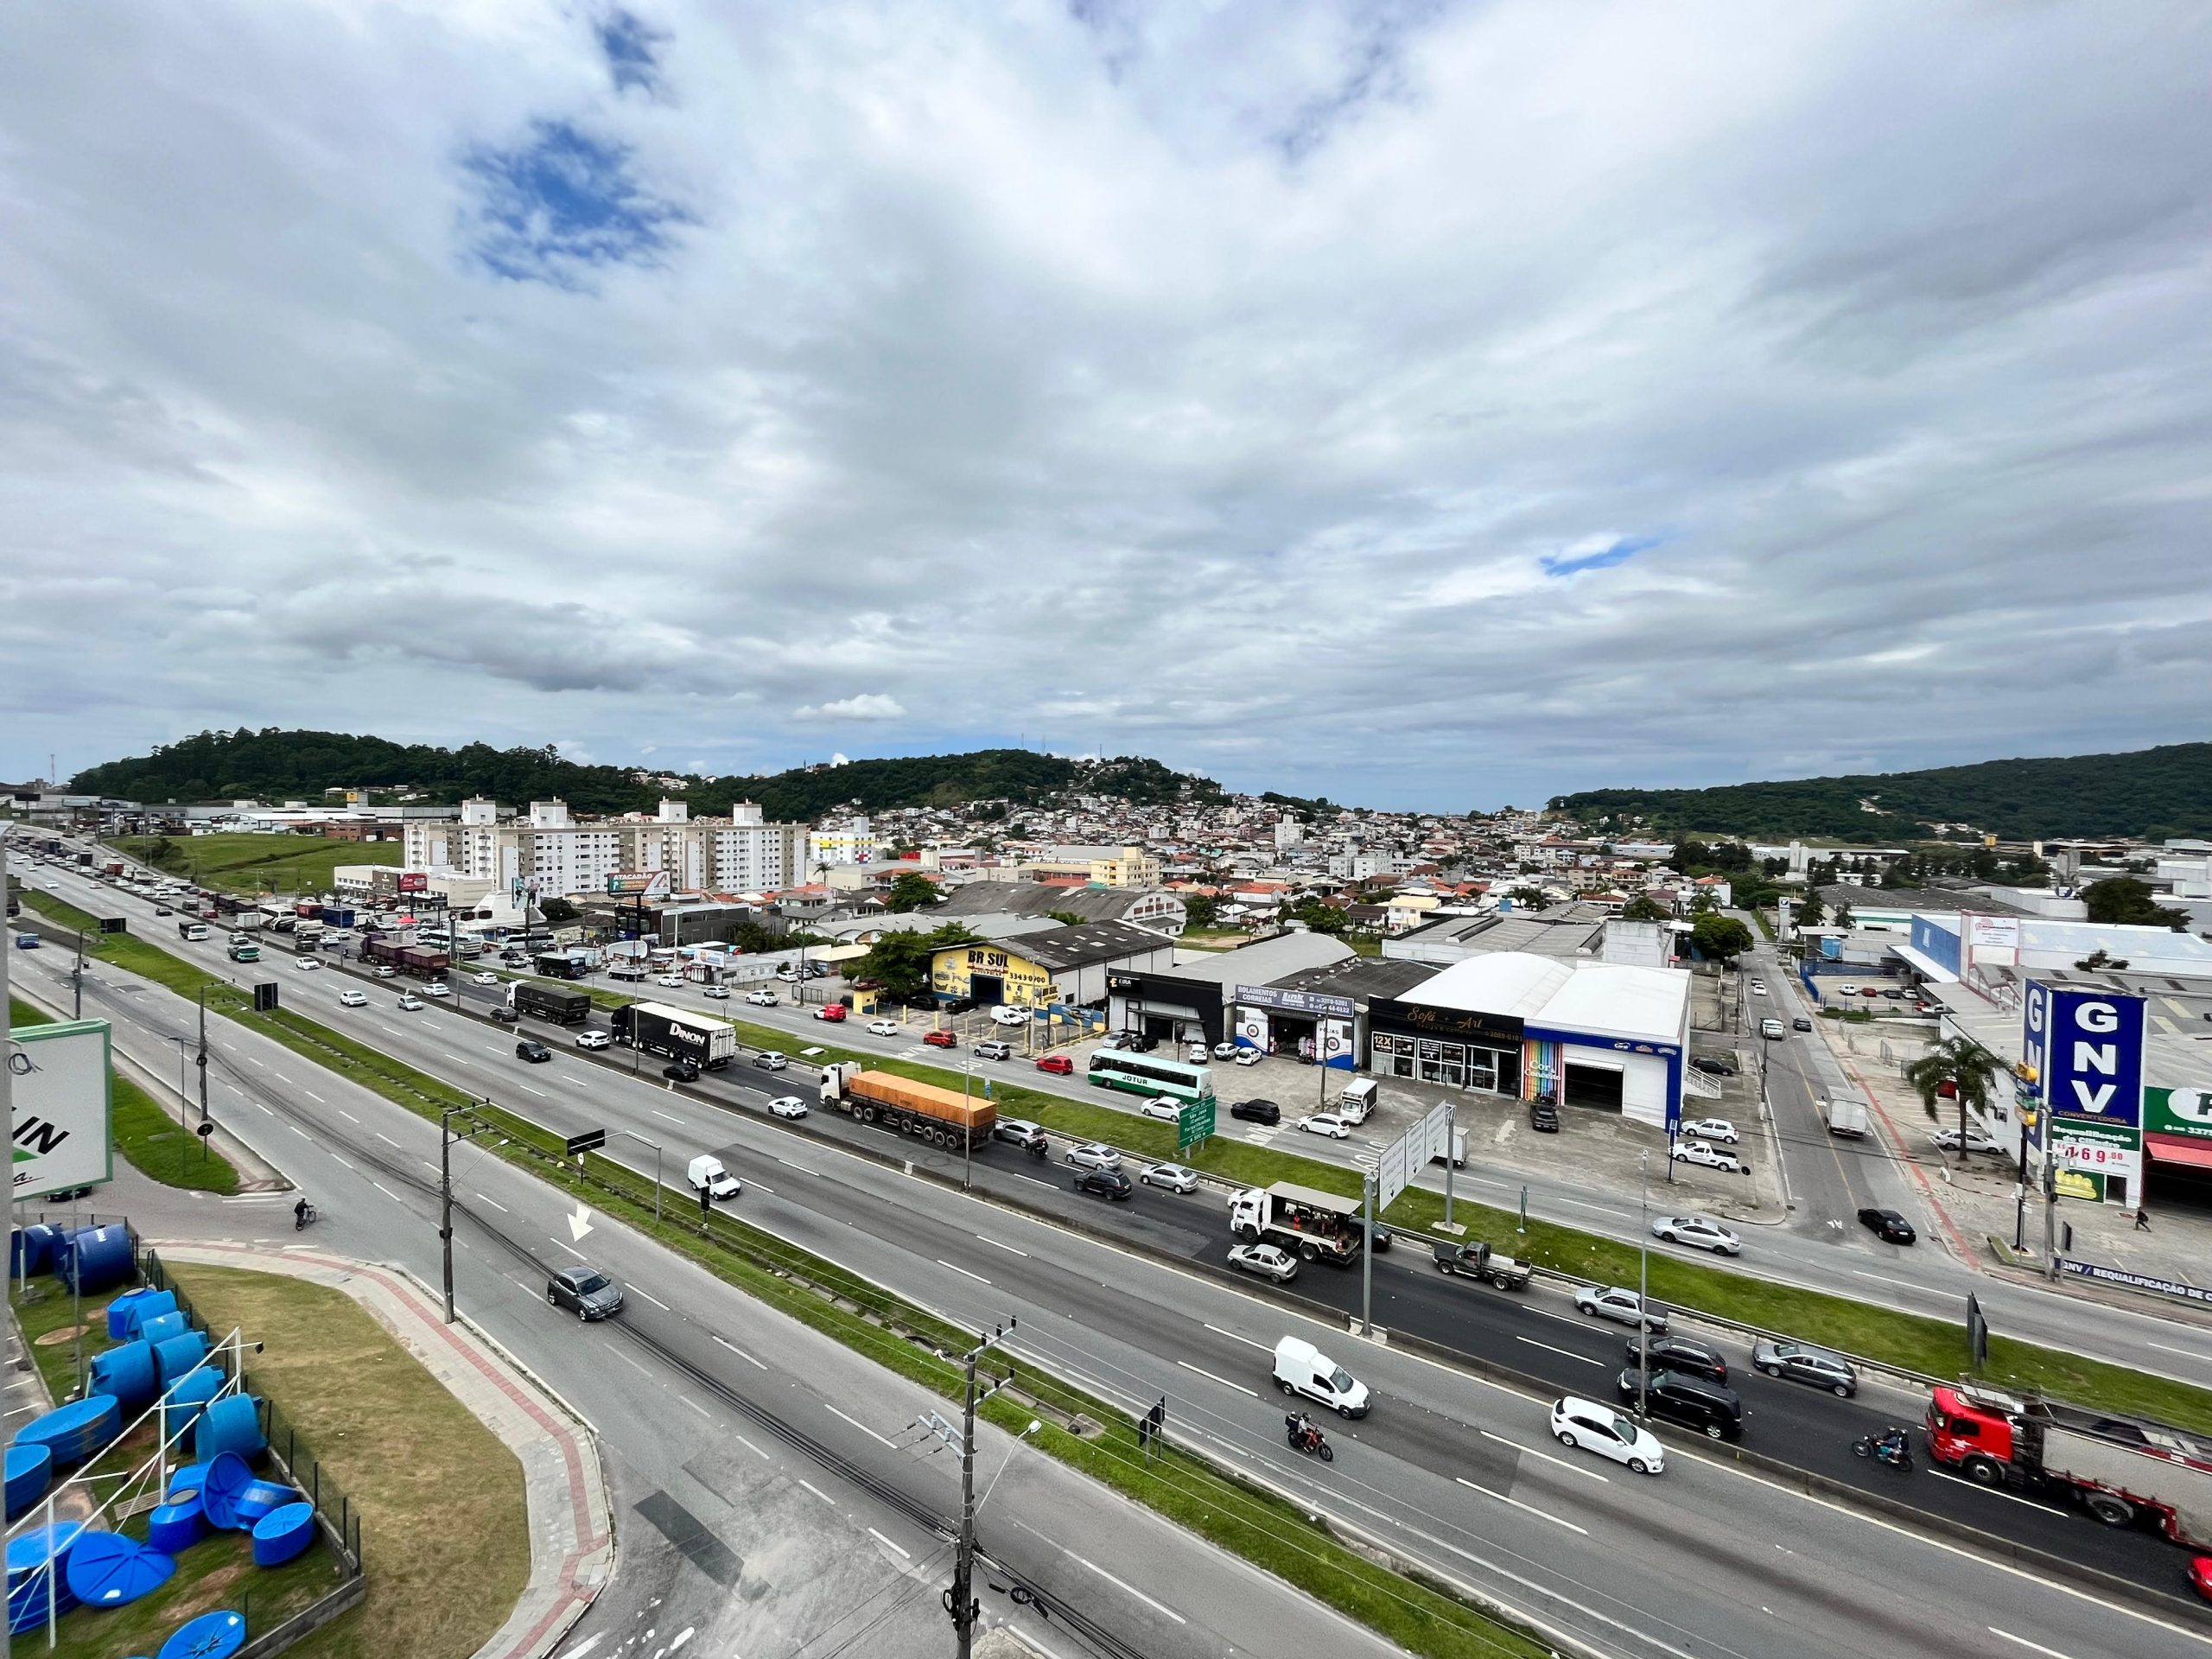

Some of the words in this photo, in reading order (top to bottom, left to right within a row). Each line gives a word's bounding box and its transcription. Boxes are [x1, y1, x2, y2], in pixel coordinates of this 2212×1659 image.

[613, 872, 653, 880] ATACADÃO
[968, 950, 984, 964] BR
[987, 952, 1009, 968] SUL
[1237, 986, 1278, 998] ROLAMENTOS
[1242, 994, 1273, 1004] CORREIAS
[1530, 1059, 1551, 1071] Cor
[1122, 1074, 1148, 1085] JOTUR
[2093, 1267, 2186, 1294] REQUALIFICAÇÃO
[2187, 1287, 2204, 1300] DE
